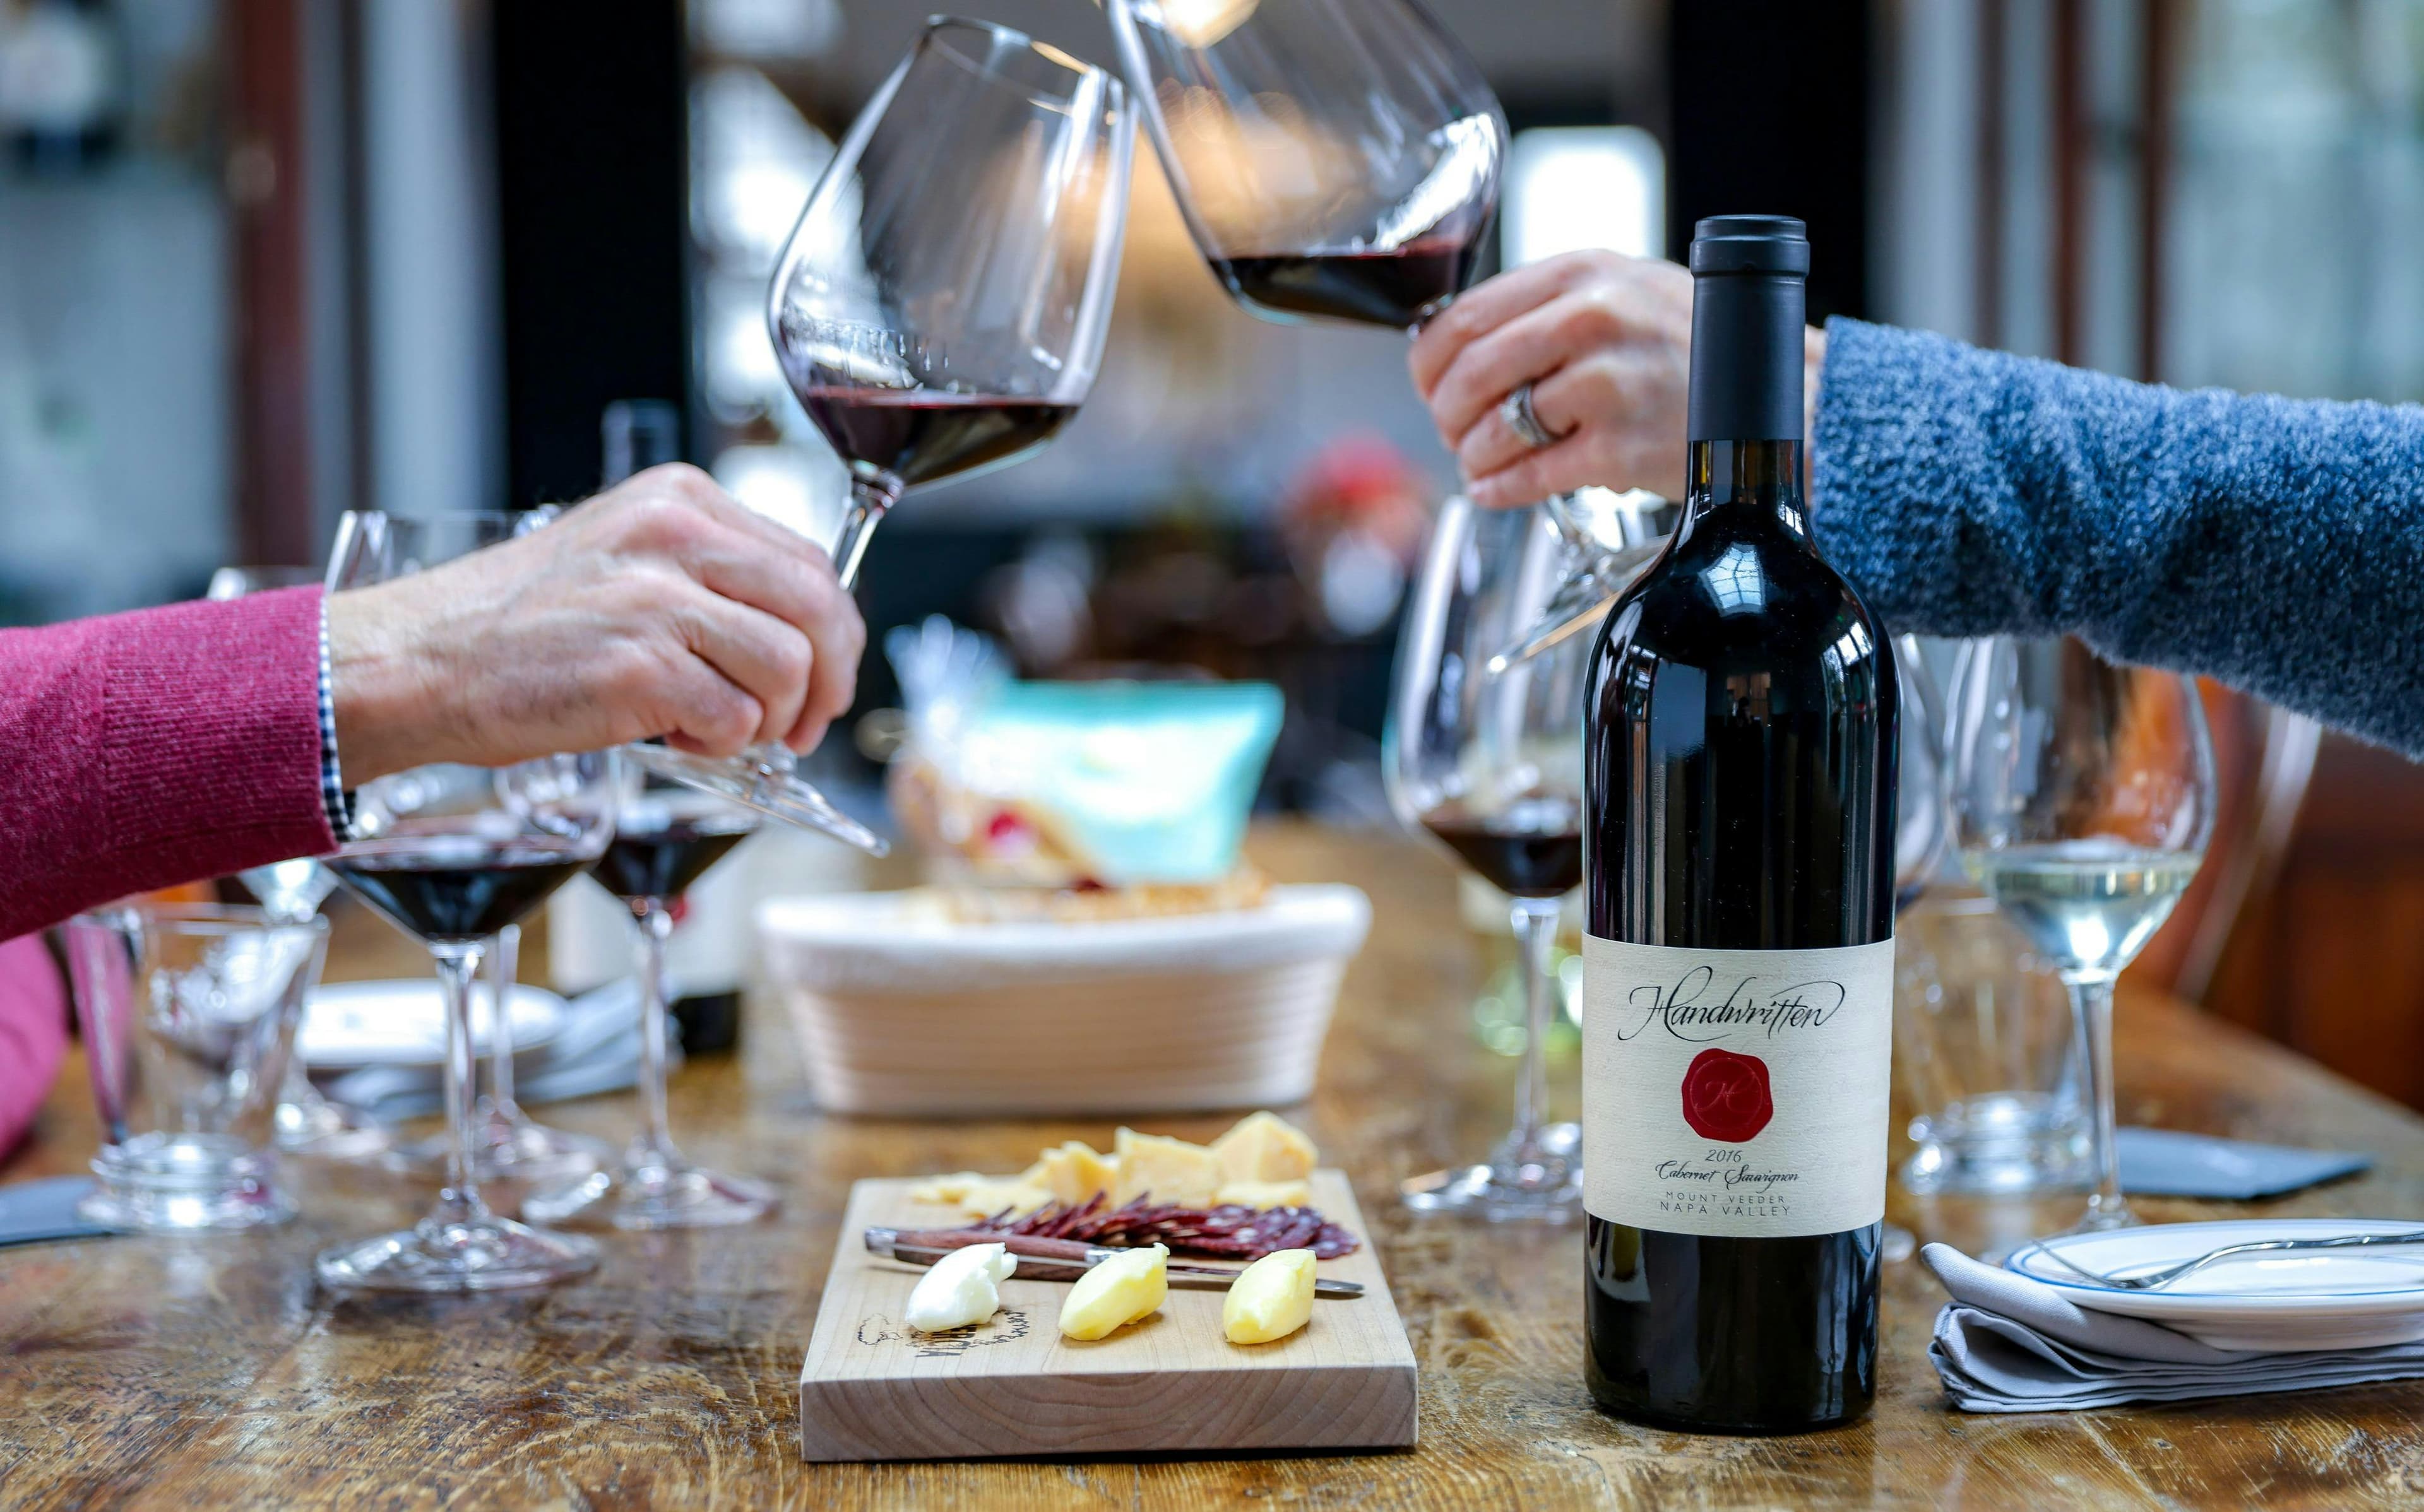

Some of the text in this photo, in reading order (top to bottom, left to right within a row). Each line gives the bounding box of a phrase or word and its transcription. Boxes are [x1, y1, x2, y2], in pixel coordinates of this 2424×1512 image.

[1617, 966, 1845, 1042] Handwritten
[1705, 1149, 1742, 1162] 2016
[1655, 1161, 1799, 1193] Cabernet Sauvignon
[1666, 1191, 1785, 1204] MOUNT VEEDER
[1660, 1201, 1790, 1217] NAPA VALLEY
